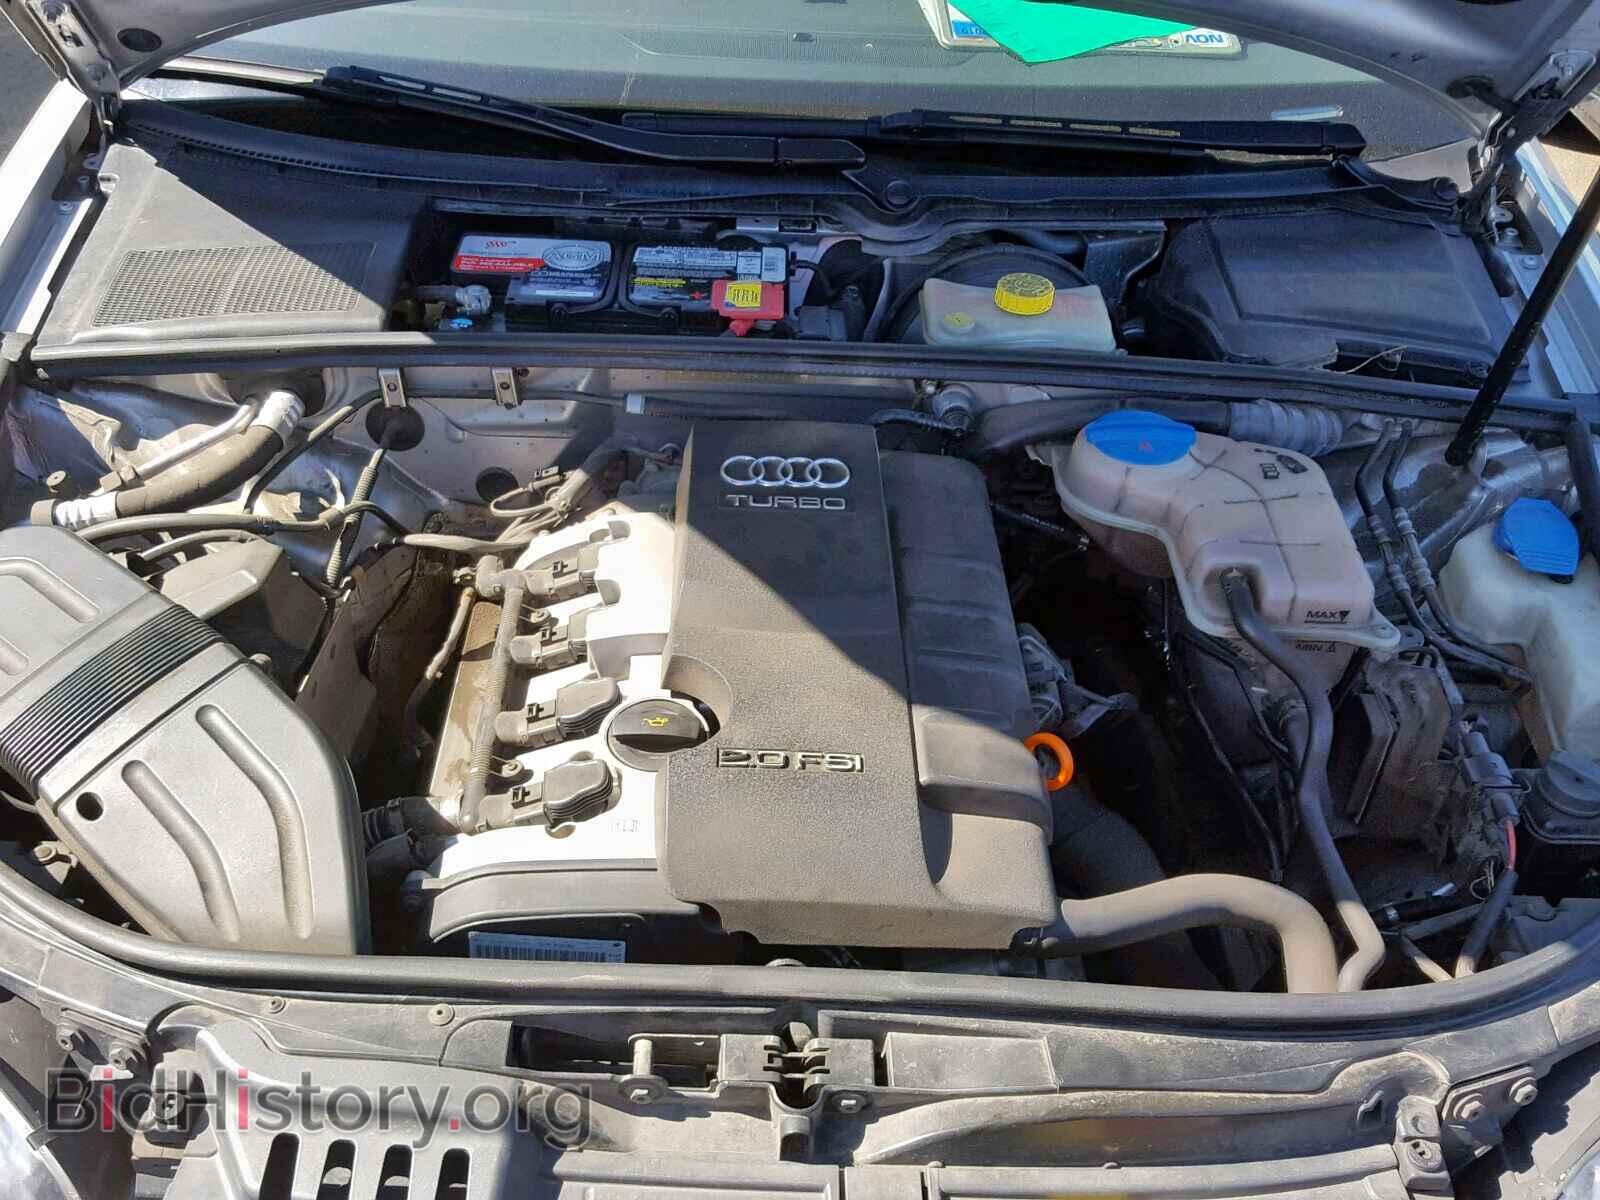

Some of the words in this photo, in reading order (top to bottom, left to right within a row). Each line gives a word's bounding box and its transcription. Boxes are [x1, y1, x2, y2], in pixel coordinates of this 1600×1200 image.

[1185, 34, 1224, 43] NOV
[726, 494, 846, 510] TURBO
[1305, 610, 1335, 618] MAX
[717, 748, 790, 769] 2.0
[795, 751, 865, 774] FSI
